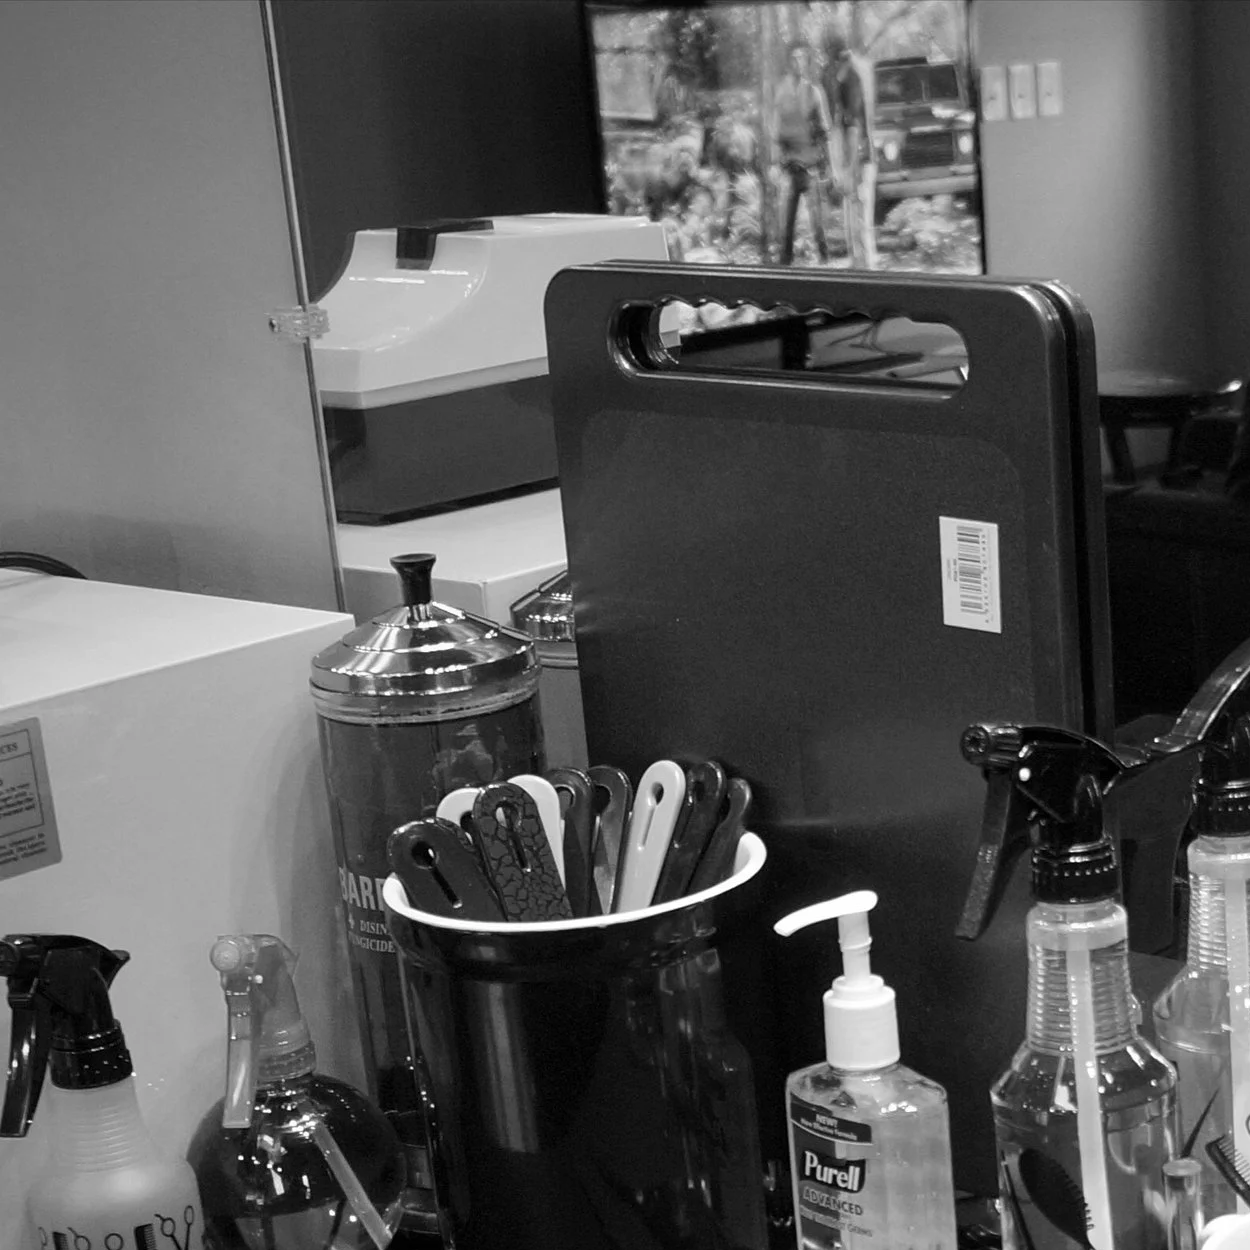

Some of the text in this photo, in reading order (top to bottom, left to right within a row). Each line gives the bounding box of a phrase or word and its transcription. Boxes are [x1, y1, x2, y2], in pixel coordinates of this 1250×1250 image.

[360, 920, 393, 937] DISIN
[804, 1150, 861, 1191] Purell
[802, 1186, 864, 1216] ADVANCED
